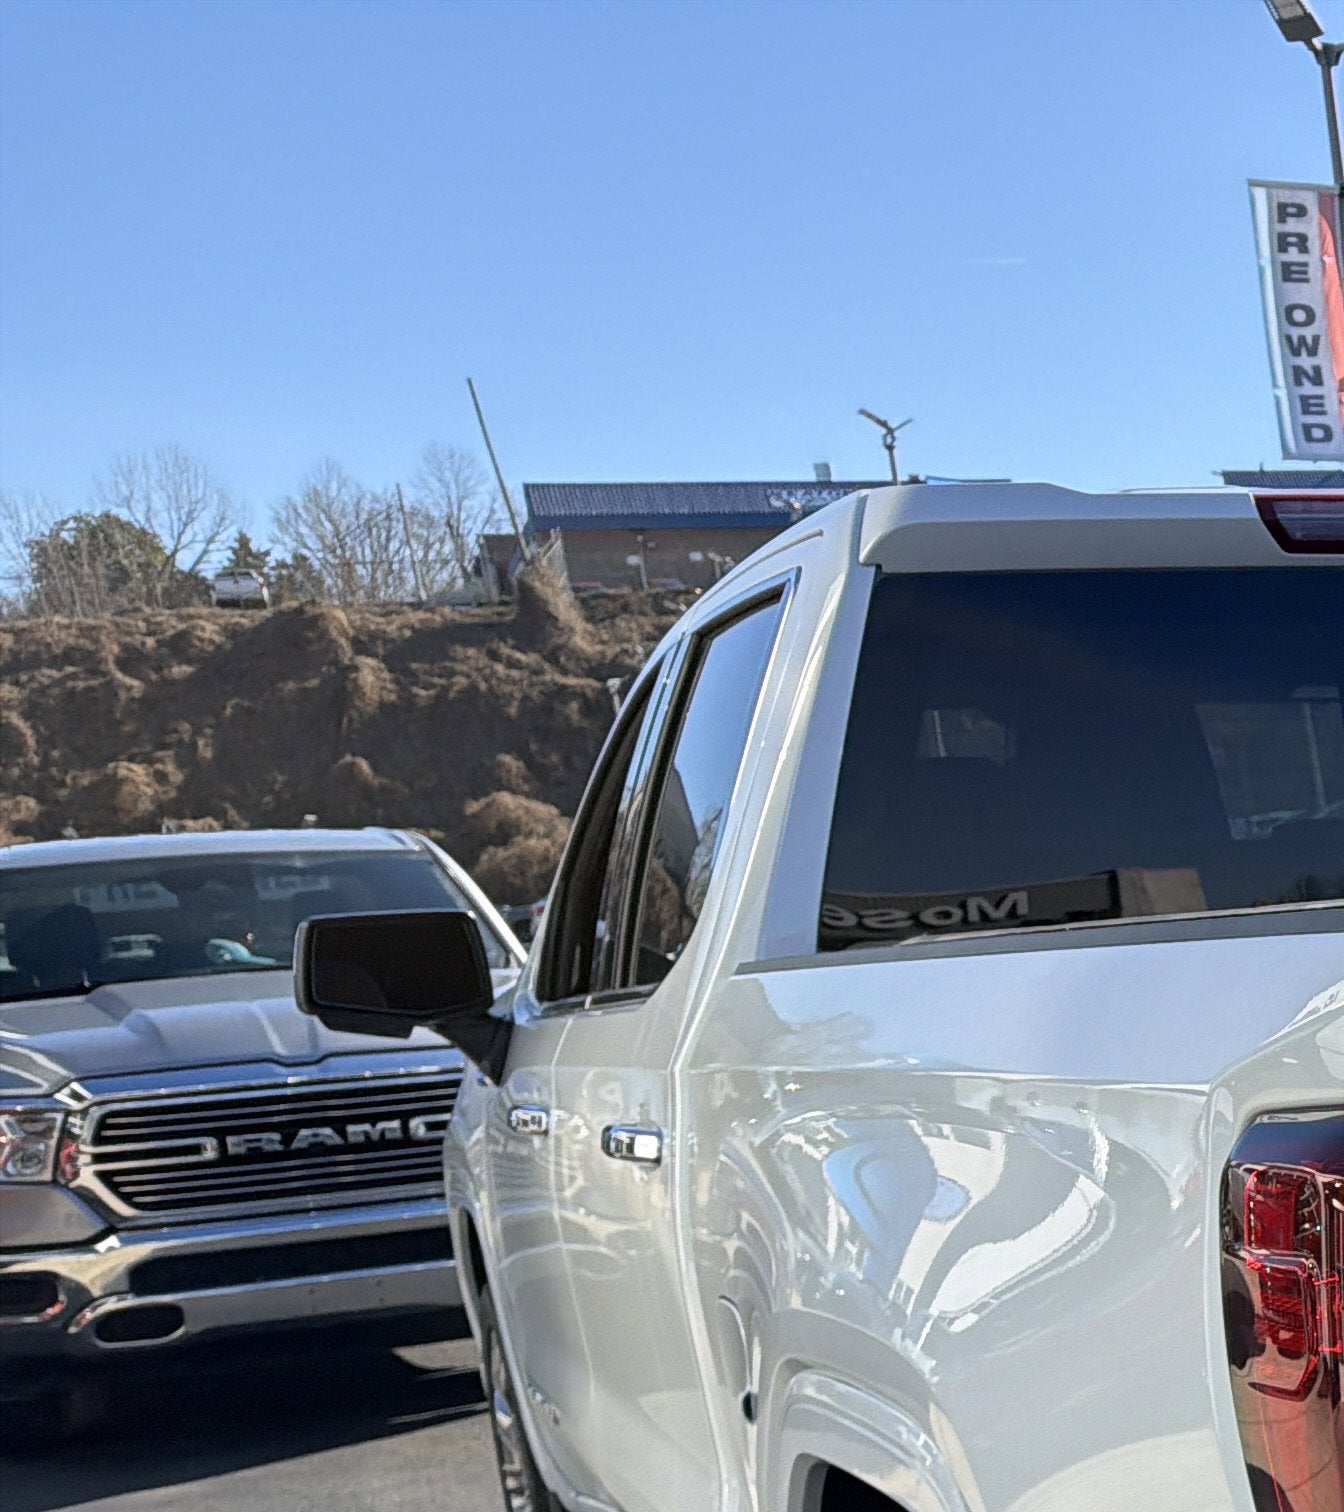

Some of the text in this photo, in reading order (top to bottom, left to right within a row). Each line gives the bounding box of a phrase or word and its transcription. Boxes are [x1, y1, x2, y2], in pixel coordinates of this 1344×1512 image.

[1276, 201, 1334, 445] PRE OWNED
[226, 1118, 403, 1157] RAM
